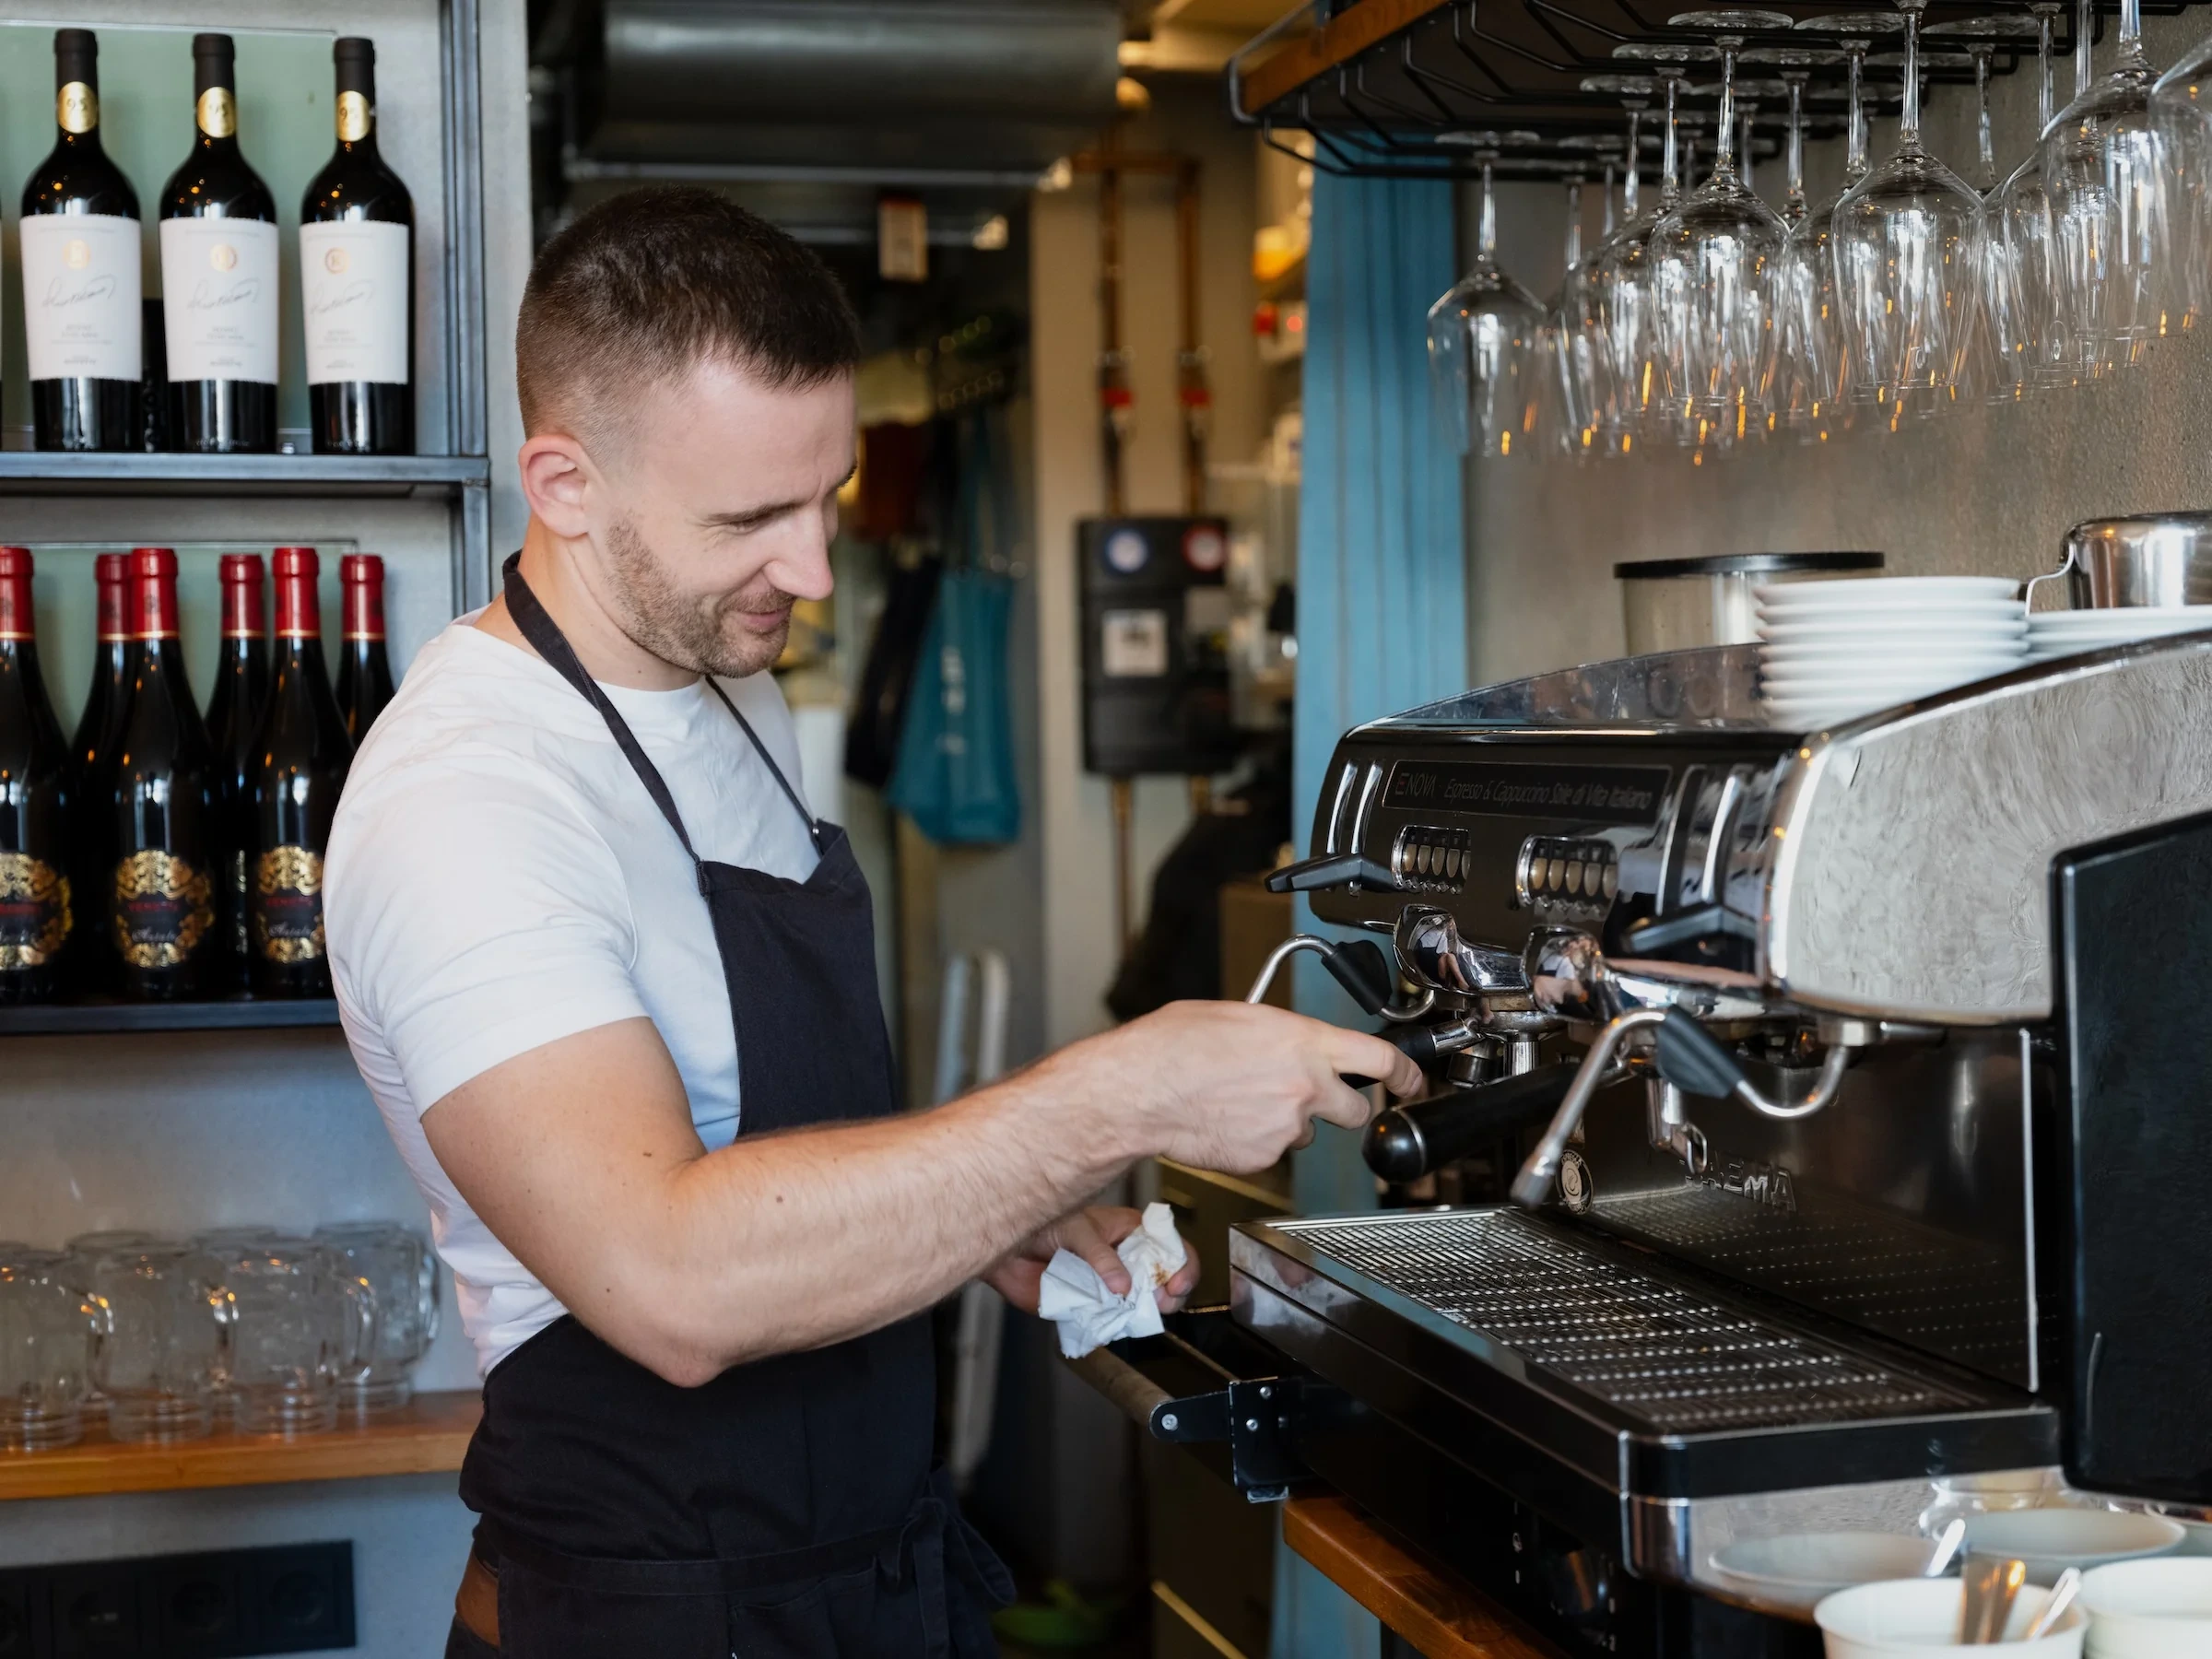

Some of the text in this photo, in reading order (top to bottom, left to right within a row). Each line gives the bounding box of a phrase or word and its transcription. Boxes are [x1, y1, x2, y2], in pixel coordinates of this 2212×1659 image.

[1394, 772, 1437, 798] ENOVA
[1443, 778, 1484, 804] Espresso
[1493, 781, 1550, 808] Cappuccino
